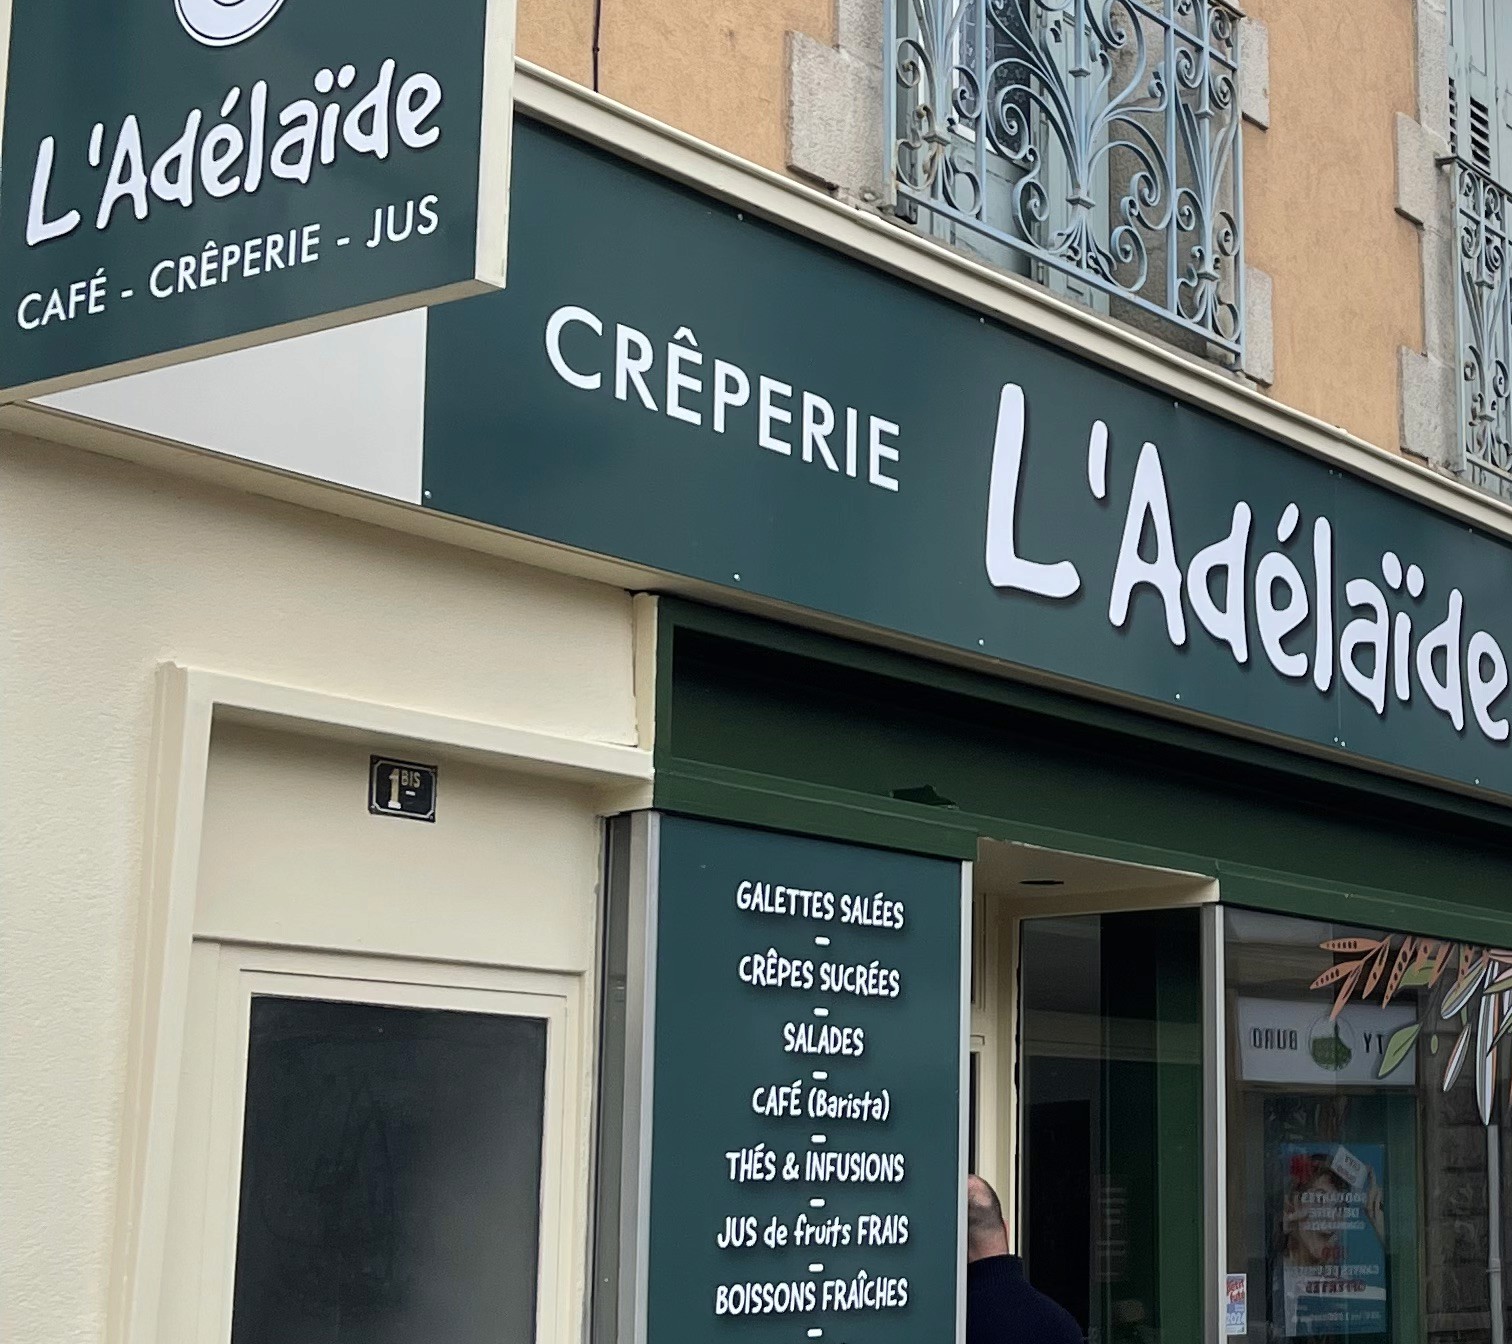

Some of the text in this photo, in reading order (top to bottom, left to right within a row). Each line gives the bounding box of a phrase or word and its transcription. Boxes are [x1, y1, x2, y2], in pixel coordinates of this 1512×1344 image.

[27, 59, 441, 248] L'Adélaïde
[18, 268, 106, 329] CAFÉ
[150, 224, 320, 297] CRÊPERIE
[367, 195, 438, 247] JUS
[546, 306, 899, 491] CRÊPERIE
[986, 381, 1512, 743] L'Adélaïde
[737, 881, 903, 929] GALETTES SALÉES
[740, 948, 899, 997] CRÊPES SUCRÉES
[784, 1023, 863, 1056] SALADES
[753, 1080, 889, 1121] CAFÉ (Barista)
[726, 1143, 904, 1182] THÉS & INFUSIONS
[718, 1214, 908, 1248] JUS de fruits FRAIS
[716, 1270, 908, 1314] BOISSONS FRAÎCHES
